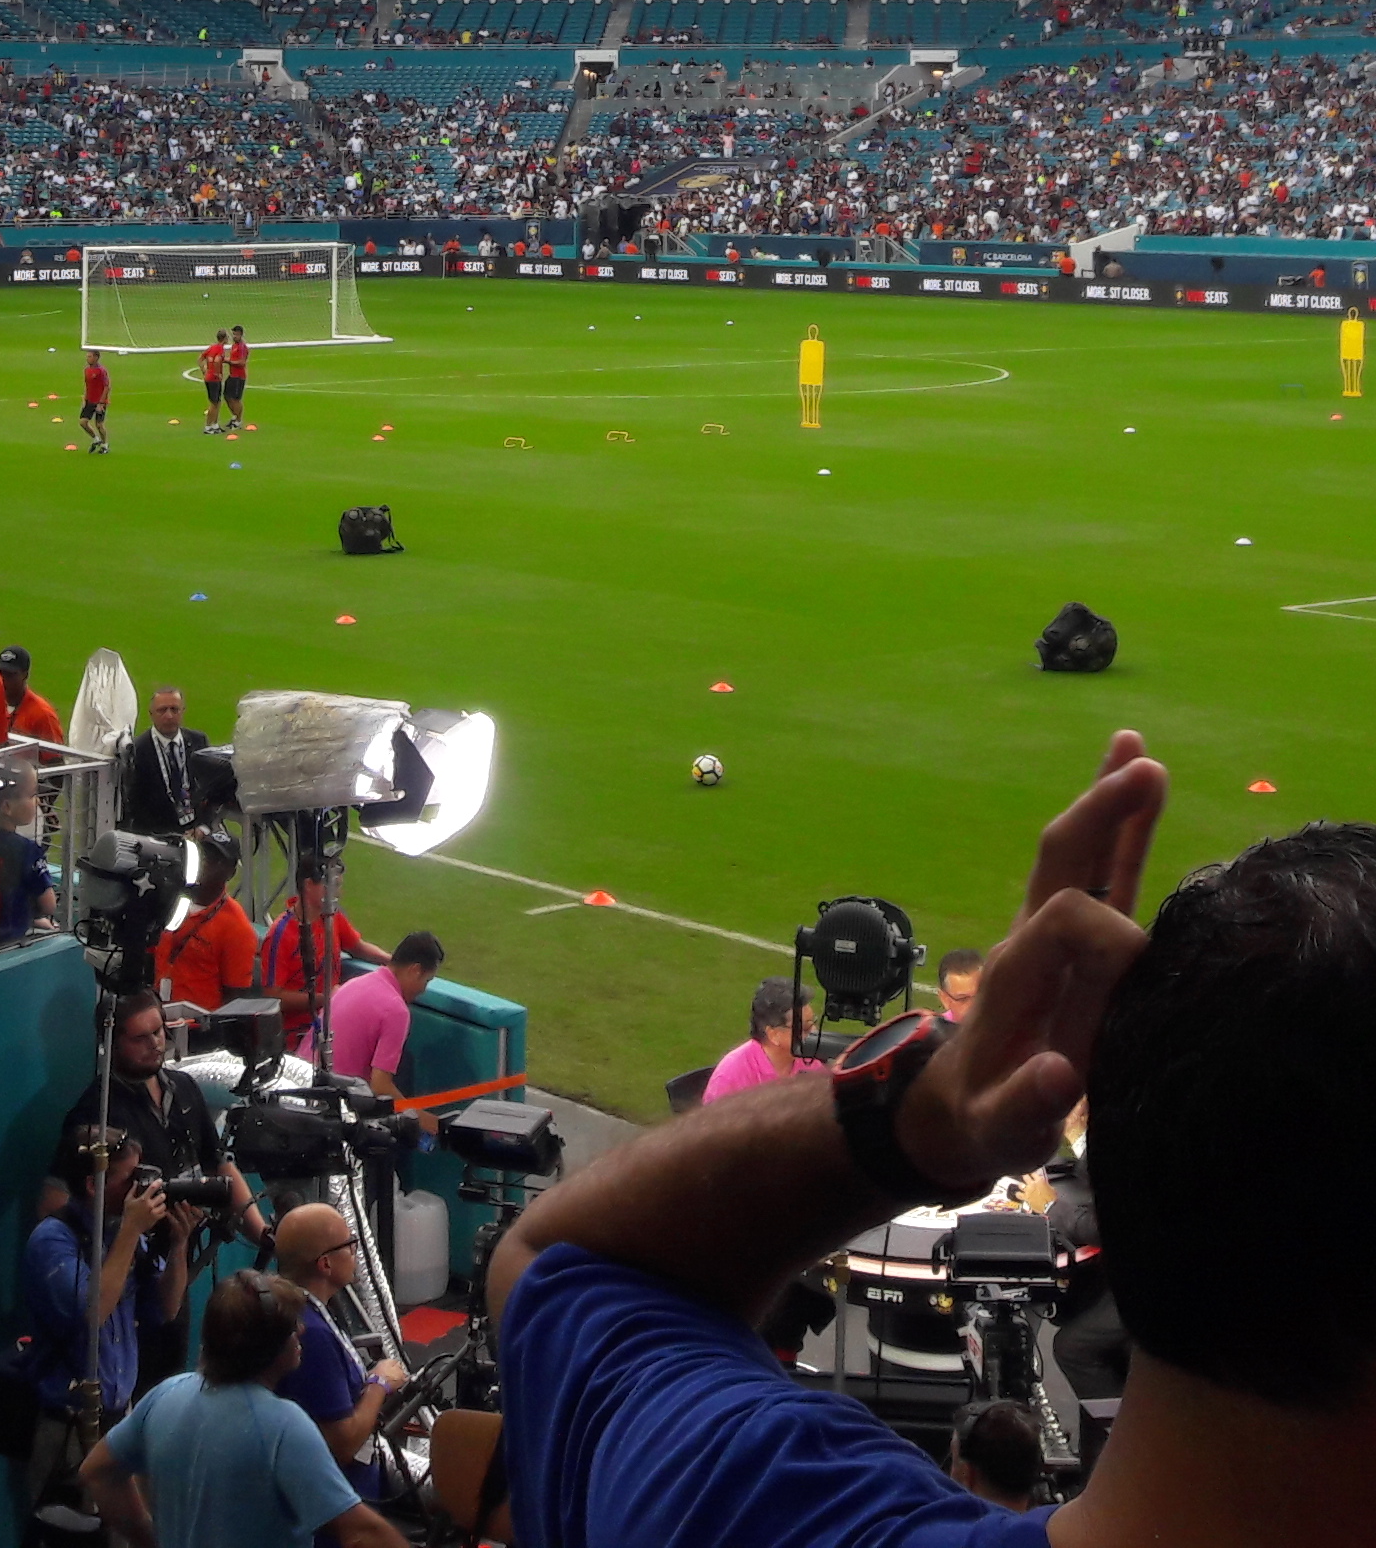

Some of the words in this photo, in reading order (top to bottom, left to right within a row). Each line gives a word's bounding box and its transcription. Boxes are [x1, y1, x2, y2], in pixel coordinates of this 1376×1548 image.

[995, 253, 1033, 263] BARCELONA
[306, 263, 327, 274] SEATS
[361, 261, 382, 272] MORE.
[394, 261, 422, 272] CLOSER.
[463, 262, 484, 272] SEATS
[14, 270, 36, 281] MORE.
[39, 269, 50, 280] SIT
[51, 268, 81, 280] CLOSER.
[123, 268, 145, 278] SEATS
[719, 271, 736, 282] SEATS
[871, 277, 890, 289] SEATS
[1017, 283, 1039, 295] SEATS
[1086, 286, 1108, 298] MORE.
[1110, 286, 1121, 299] SIT
[1122, 288, 1151, 300] CLOSER.
[1205, 291, 1229, 304] SEATS
[1270, 294, 1294, 307] MORE.
[1296, 295, 1308, 308] SIT
[1310, 296, 1343, 310] CLOSER.
[866, 1288, 903, 1303] ESPN
